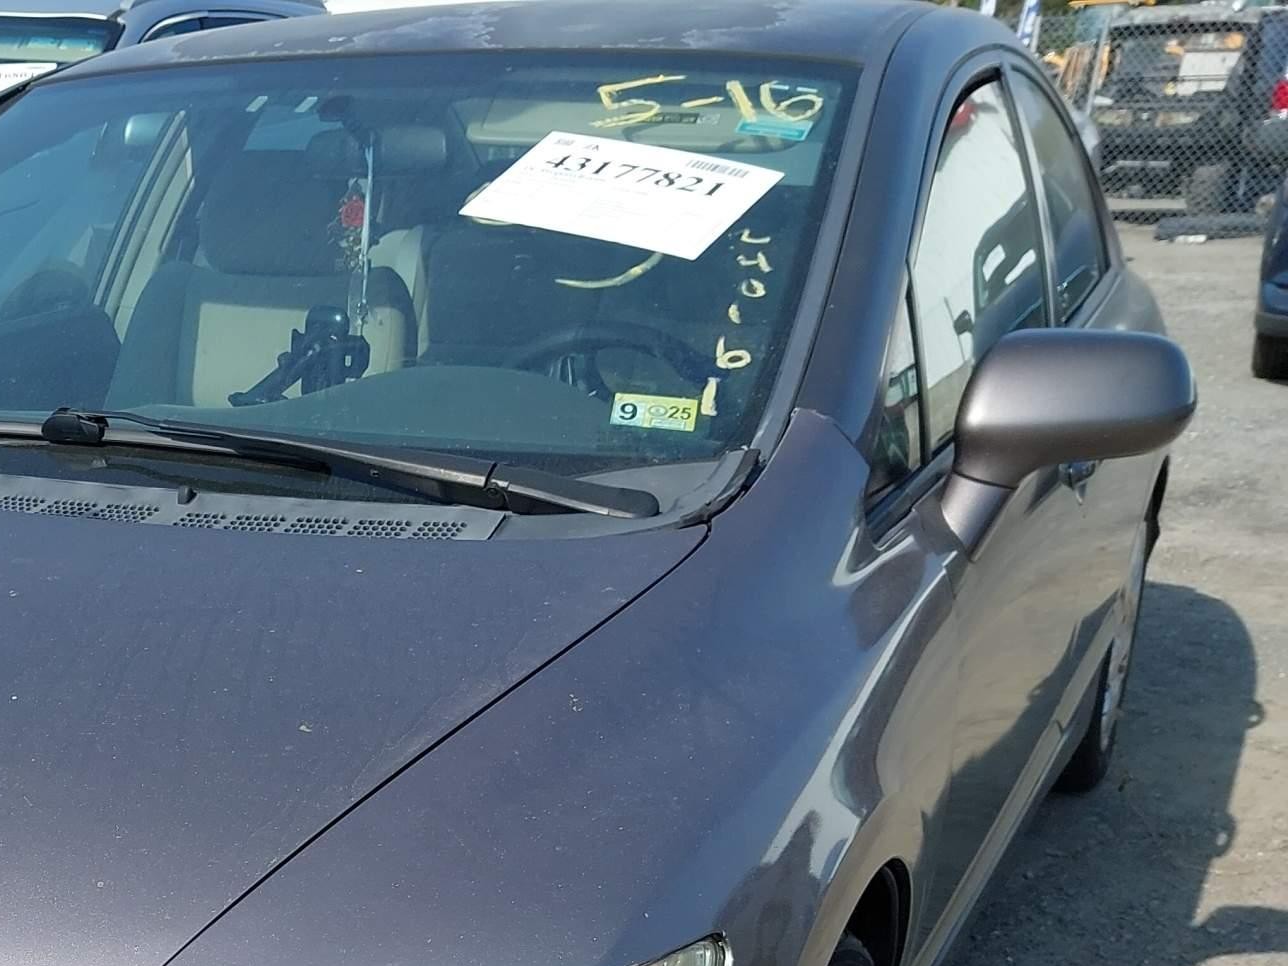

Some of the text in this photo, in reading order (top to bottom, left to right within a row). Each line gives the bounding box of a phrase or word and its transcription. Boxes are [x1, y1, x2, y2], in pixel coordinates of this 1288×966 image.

[546, 154, 725, 197] 43177821
[619, 403, 638, 421] 9
[668, 405, 691, 421] 25
